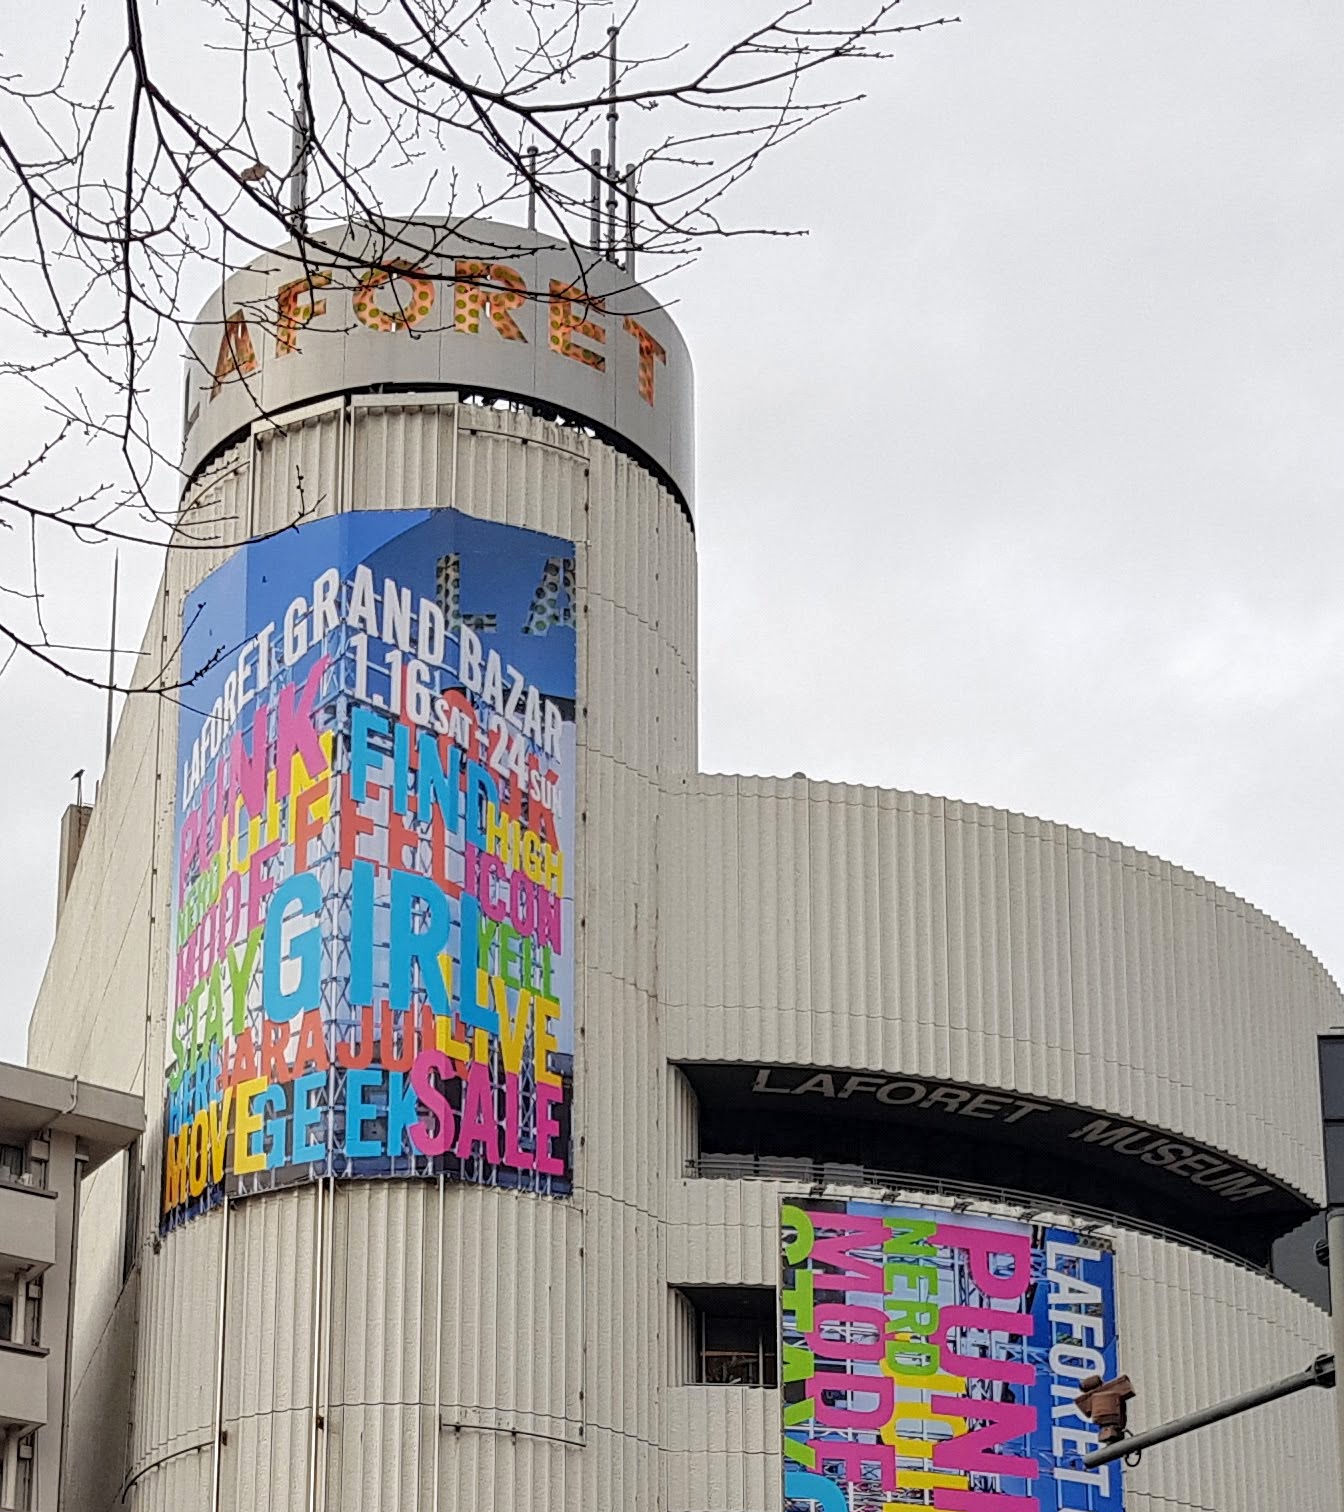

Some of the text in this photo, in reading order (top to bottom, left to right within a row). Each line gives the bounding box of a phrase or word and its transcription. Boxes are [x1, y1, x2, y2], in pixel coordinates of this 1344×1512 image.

[182, 562, 564, 814] LAFORET GRAND BAZAR
[179, 653, 501, 912] PUNK FIND
[485, 801, 564, 898] HIGH
[176, 838, 560, 1036] MODE GIRL YELL
[465, 841, 562, 956] ICON
[168, 926, 264, 1093] STAY
[435, 954, 562, 1088] LIVE
[164, 1049, 565, 1214] MOVE GEEK SALE
[752, 1067, 1277, 1203] LAFORET MUSEUM
[805, 1211, 897, 1493] MODE
[883, 1216, 941, 1376] NERD
[1046, 1240, 1111, 1499] LAFORET
